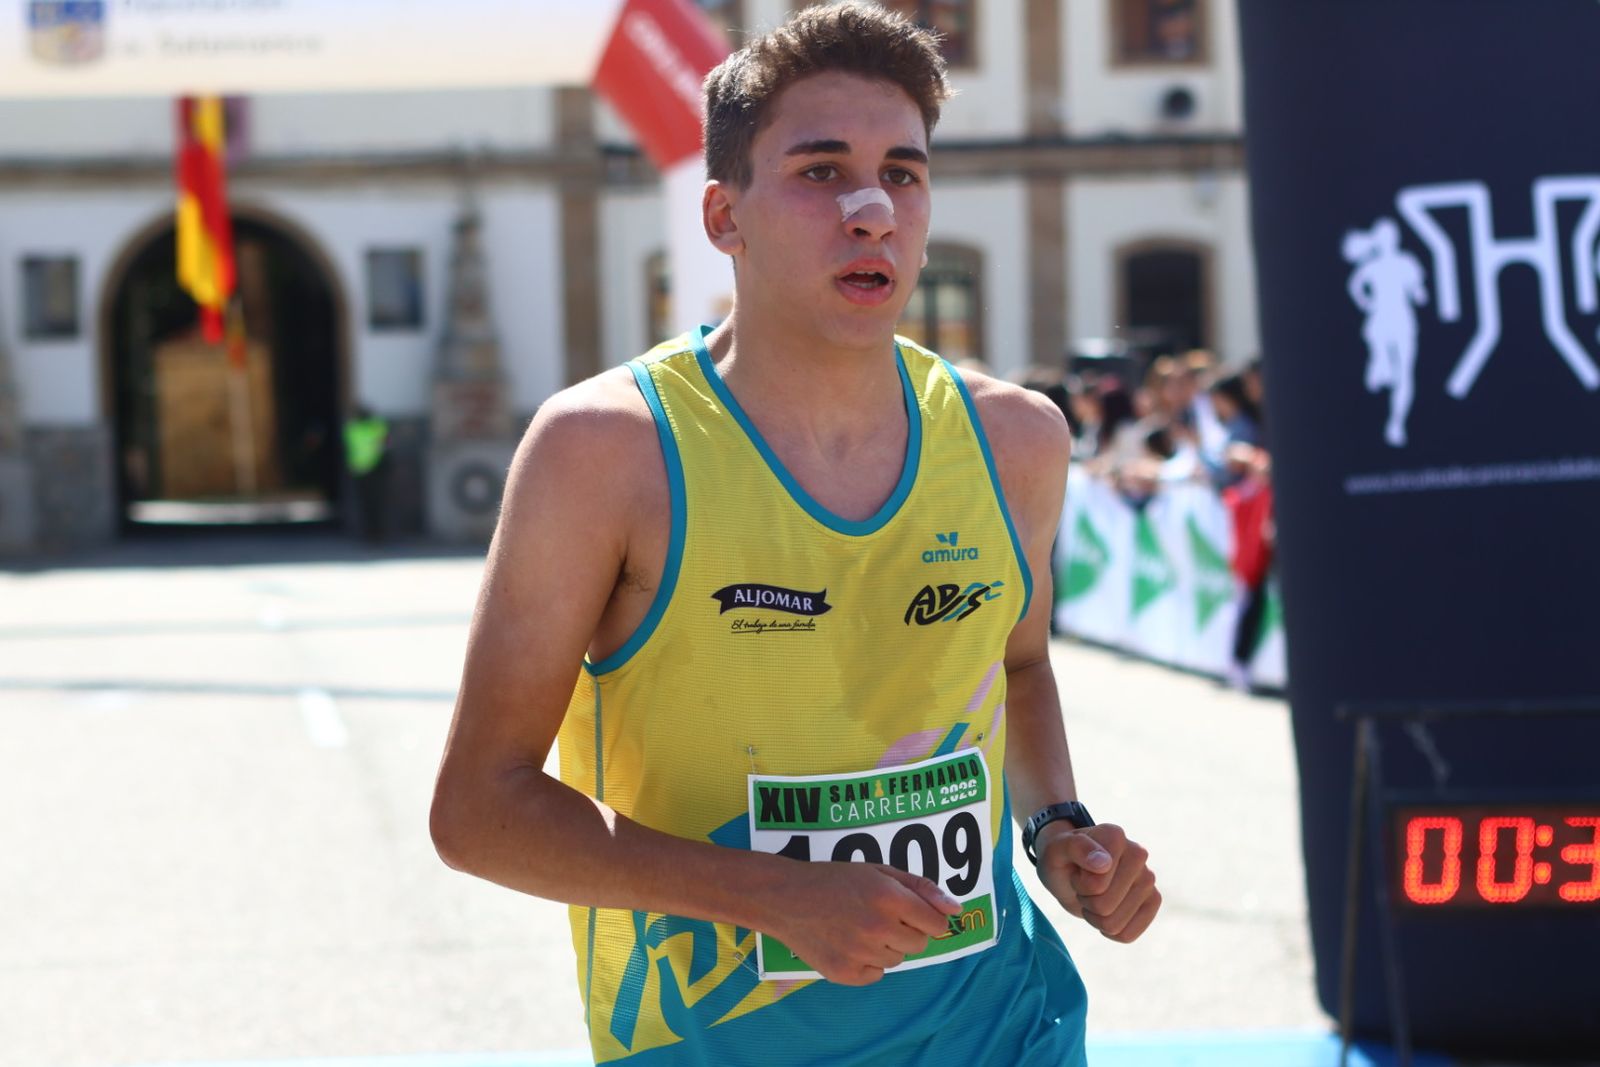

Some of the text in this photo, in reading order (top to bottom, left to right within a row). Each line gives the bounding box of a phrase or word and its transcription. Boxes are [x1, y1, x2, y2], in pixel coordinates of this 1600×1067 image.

[922, 548, 978, 563] amura
[734, 589, 813, 611] ALJOMAR
[732, 619, 744, 629] El
[769, 620, 777, 628] de
[829, 759, 980, 803] SAN FERNANDO
[758, 787, 822, 823] XIV
[829, 779, 978, 823] CARRERA 2026
